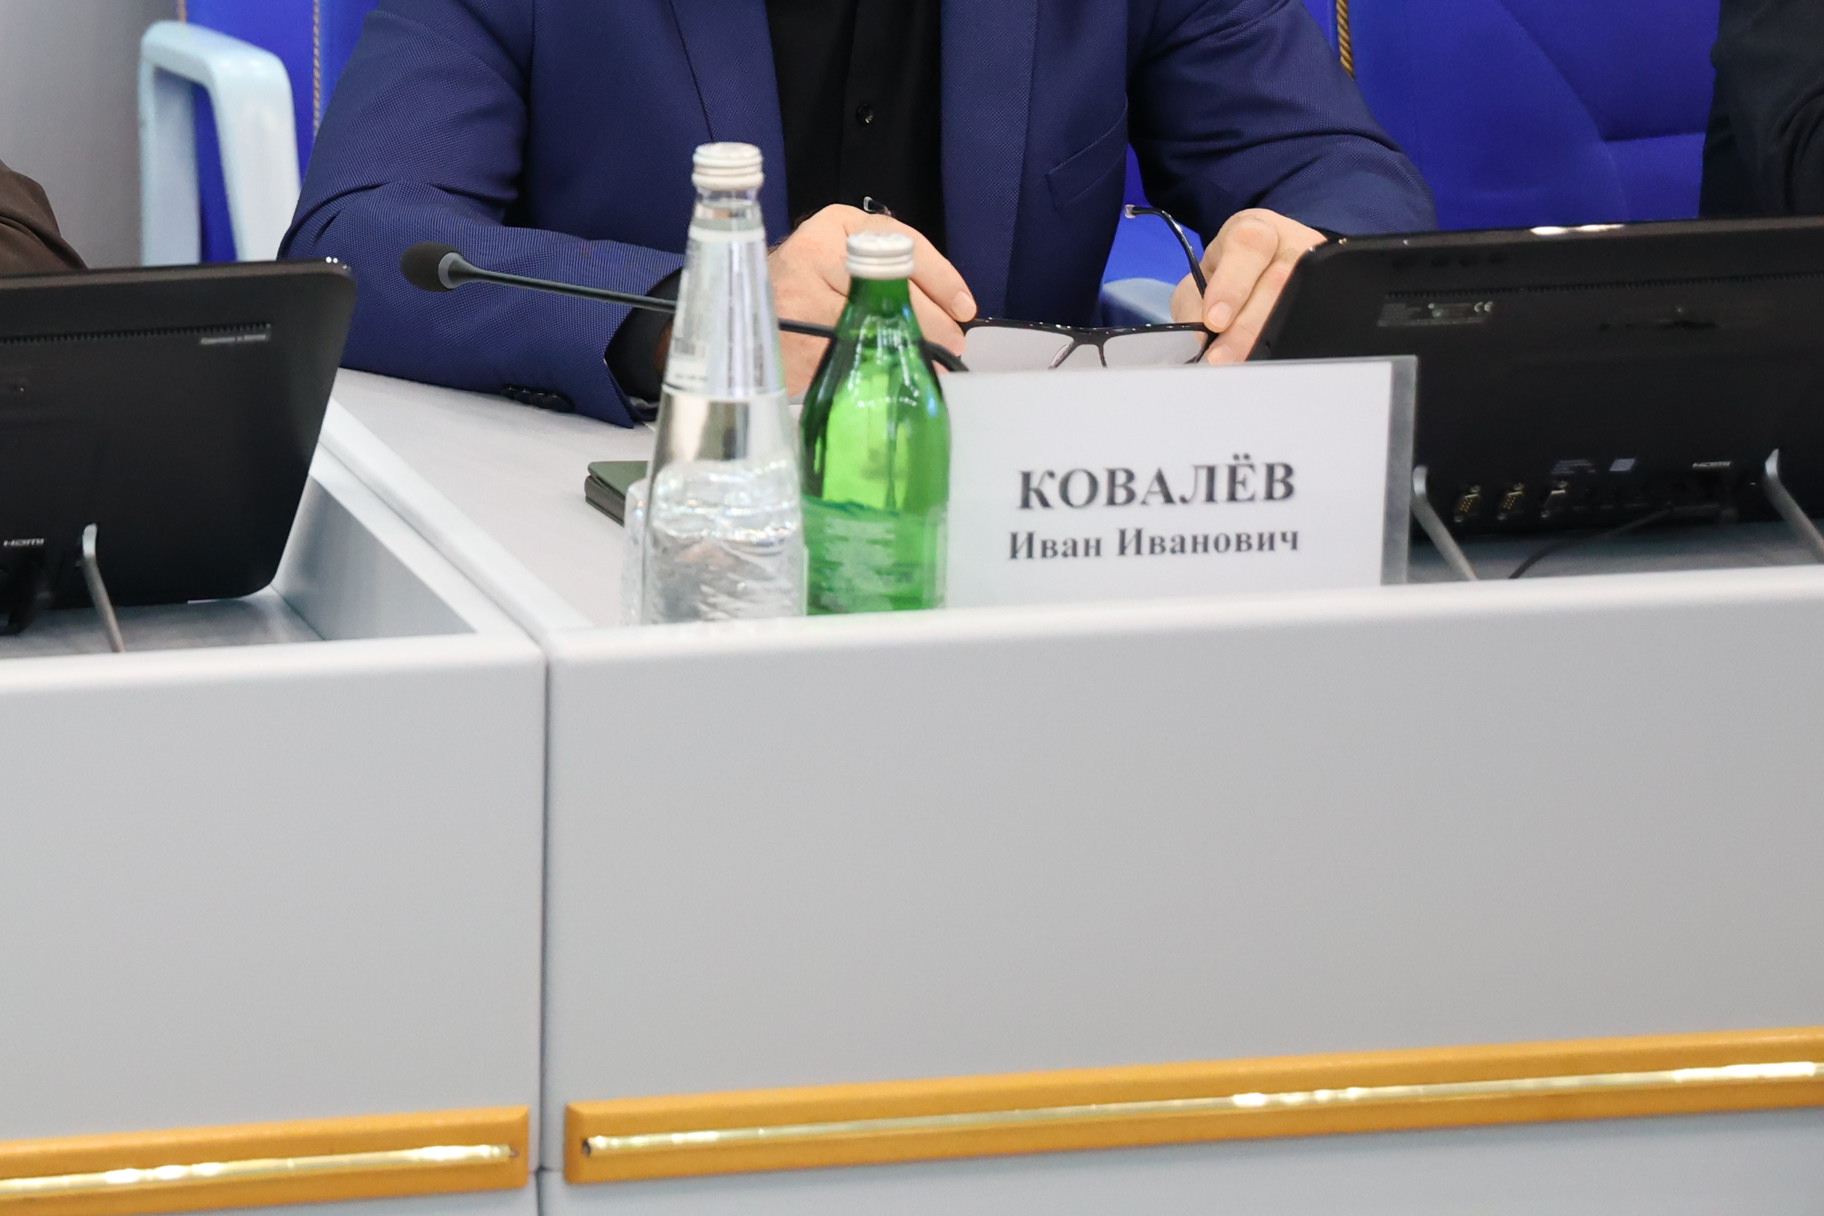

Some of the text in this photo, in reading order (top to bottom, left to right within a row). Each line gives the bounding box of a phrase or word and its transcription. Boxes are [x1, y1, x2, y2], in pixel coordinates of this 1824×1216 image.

[1017, 453, 1296, 510] КОВАЛЁВ
[1008, 528, 1300, 560] Иван Иванович
